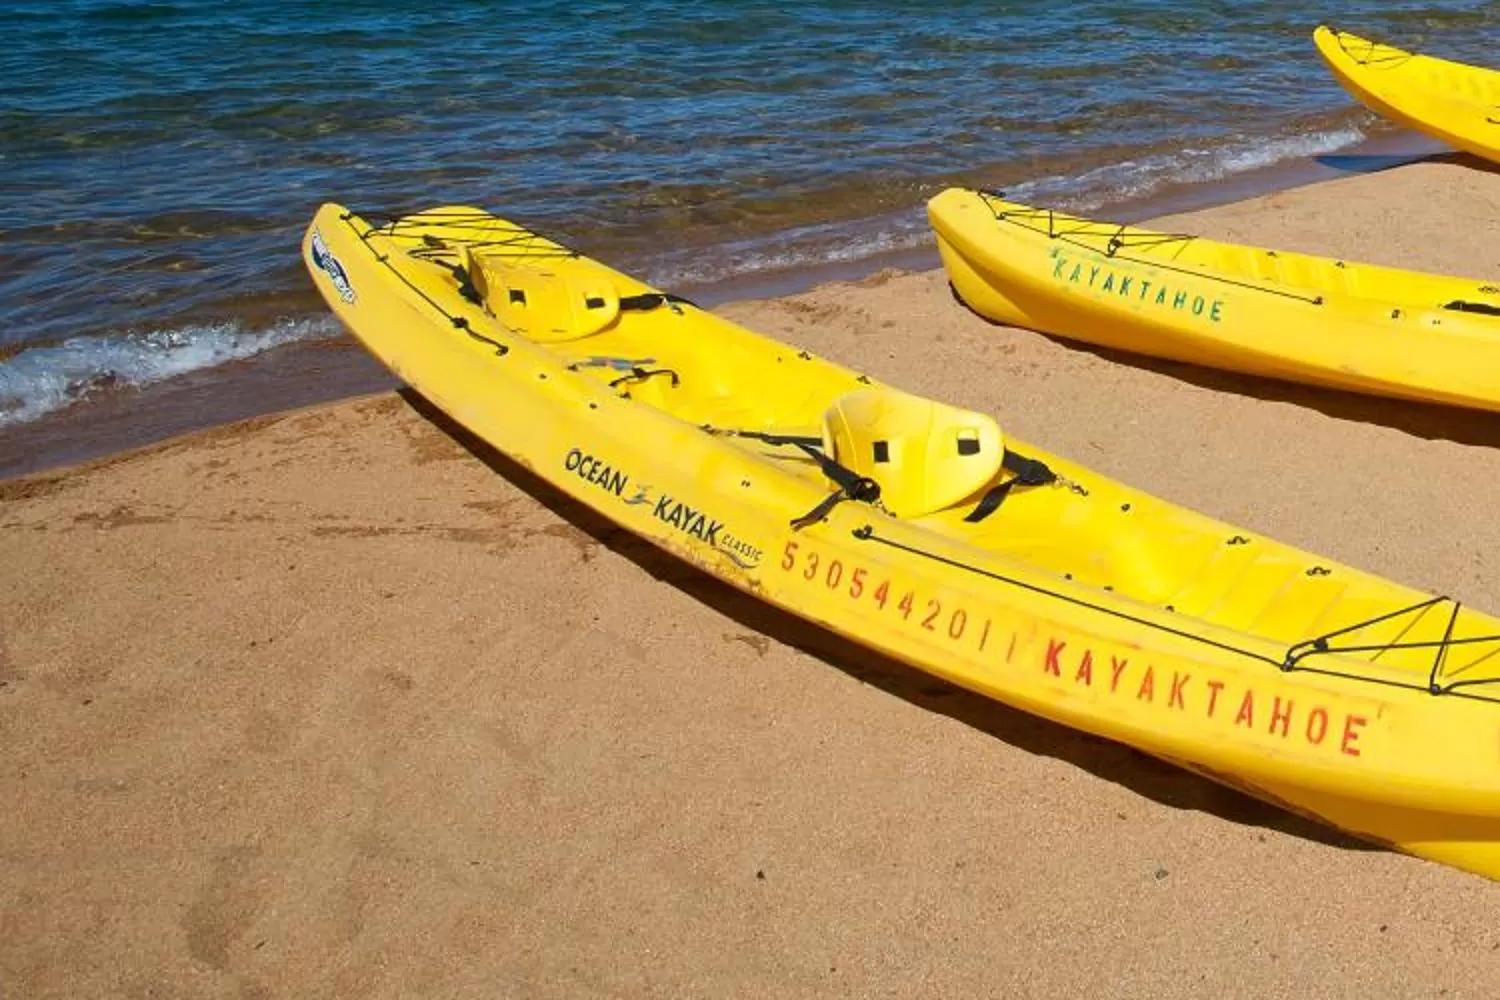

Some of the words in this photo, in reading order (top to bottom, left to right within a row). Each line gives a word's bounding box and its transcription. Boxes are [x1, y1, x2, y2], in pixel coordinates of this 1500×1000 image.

[1053, 258, 1225, 322] KAYAKTAHOE
[565, 448, 629, 497] OCEAN
[652, 493, 725, 547] KAYAK
[721, 533, 764, 563] CLASSIC
[1043, 638, 1368, 757] KAYAKTAHOE
